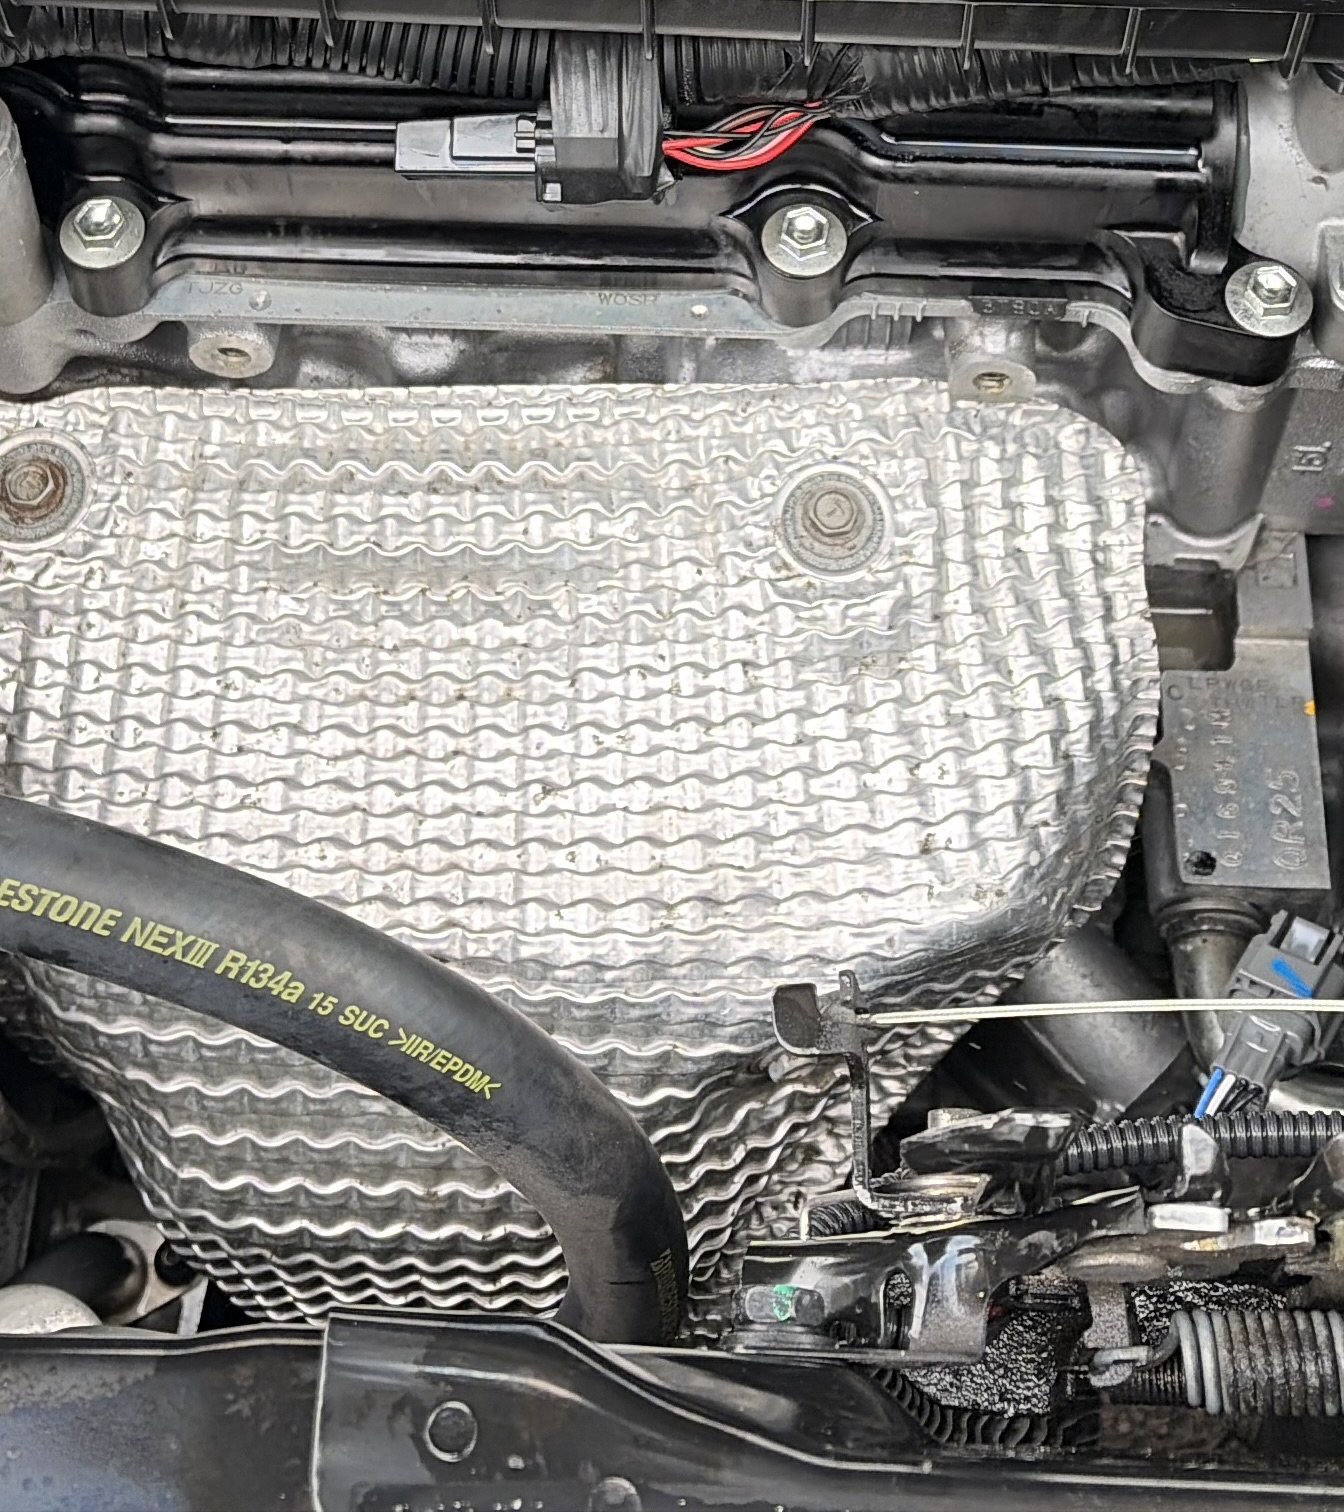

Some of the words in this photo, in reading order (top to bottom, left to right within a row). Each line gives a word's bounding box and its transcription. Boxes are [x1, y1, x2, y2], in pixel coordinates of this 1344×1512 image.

[1265, 767, 1308, 871] QR25
[214, 948, 306, 1005] R134a
[307, 991, 339, 1017] 15
[338, 1004, 390, 1041] SUC
[388, 1026, 504, 1101] >IIR/EPDM<
